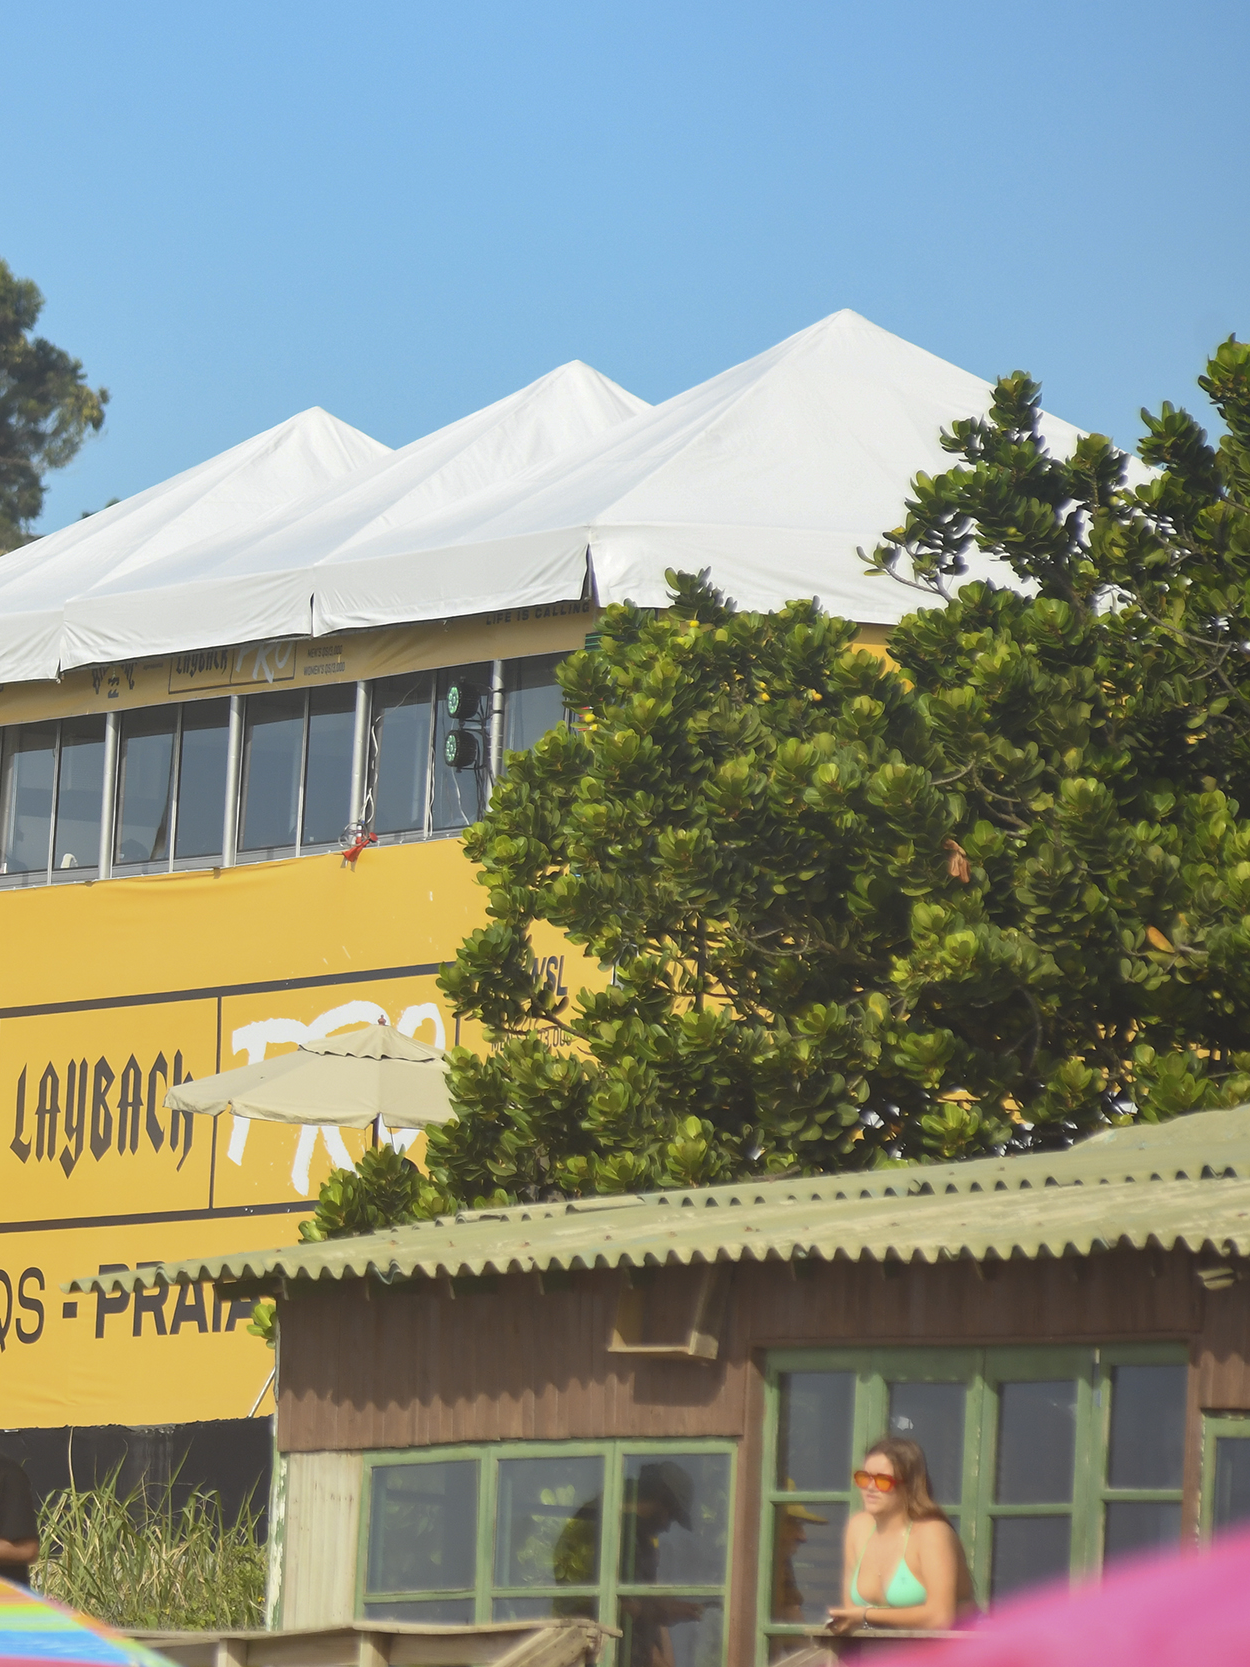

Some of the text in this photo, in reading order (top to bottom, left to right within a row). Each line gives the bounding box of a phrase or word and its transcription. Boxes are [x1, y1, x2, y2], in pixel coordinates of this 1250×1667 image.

[486, 602, 589, 626] LIFE IS CALLING
[9, 1048, 195, 1180] LAYBACK
